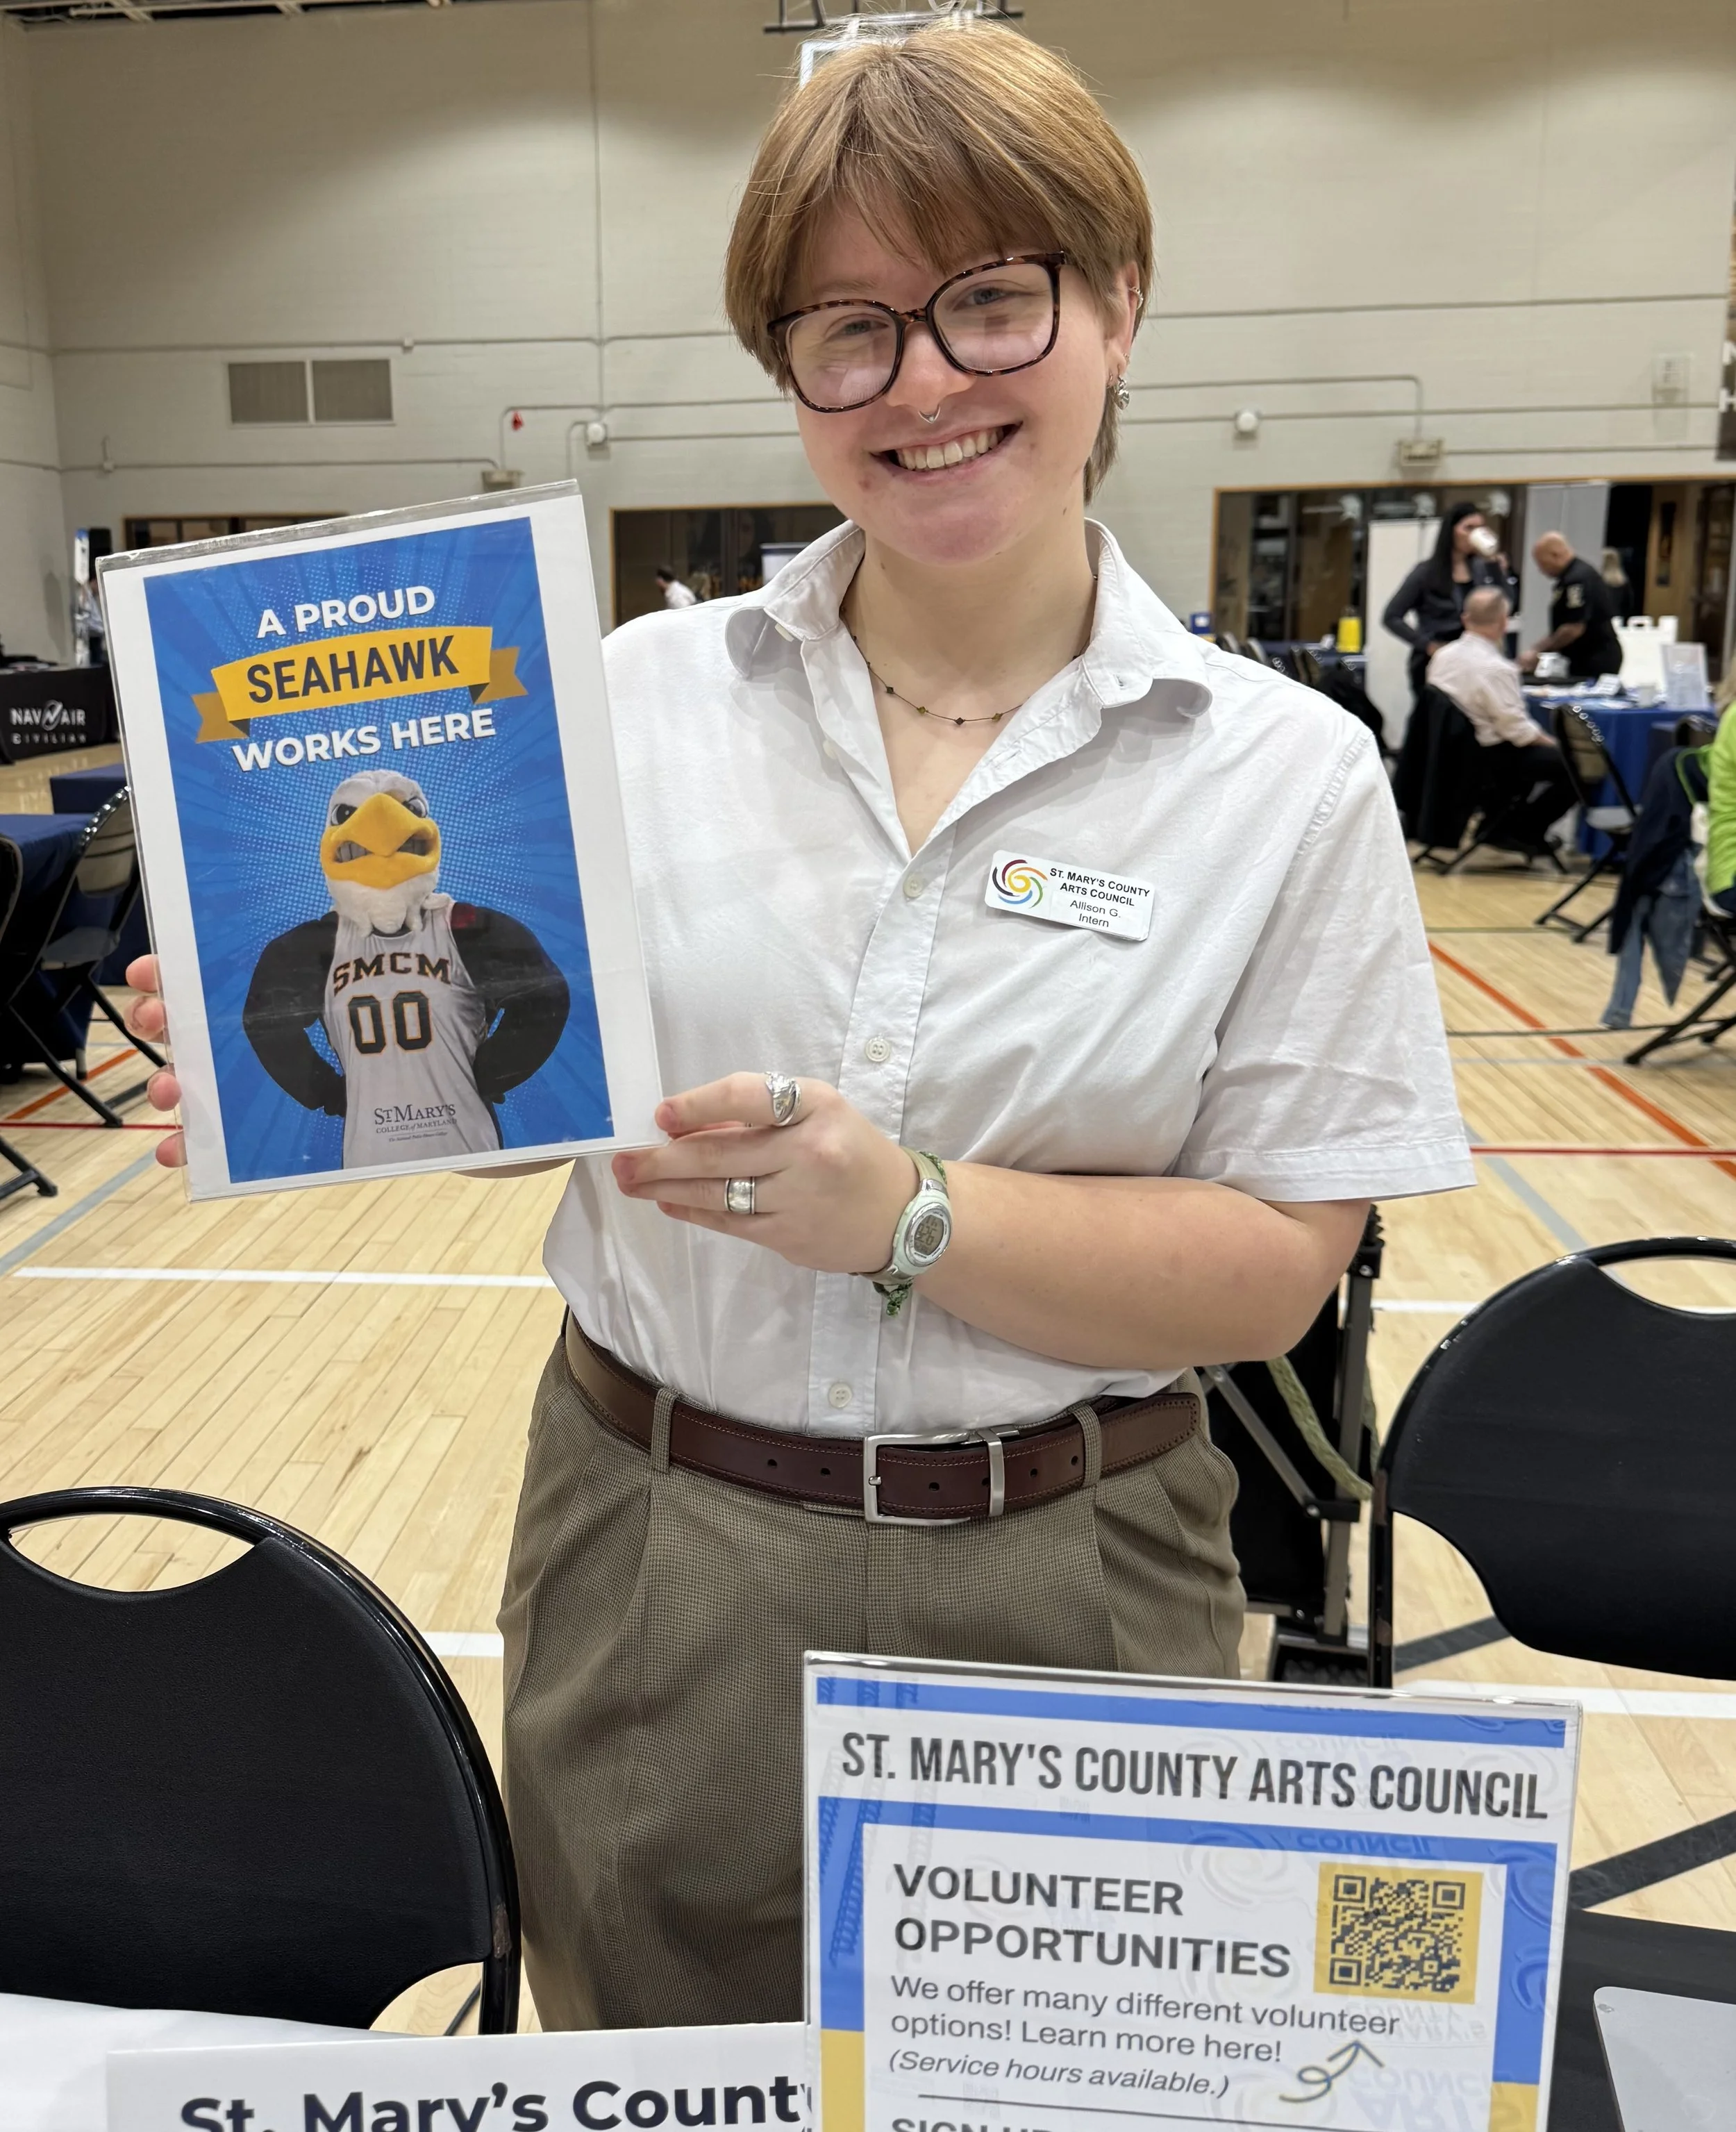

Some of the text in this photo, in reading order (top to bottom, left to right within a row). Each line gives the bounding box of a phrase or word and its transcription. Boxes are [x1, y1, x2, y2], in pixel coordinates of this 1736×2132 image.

[258, 585, 435, 639] A PROUD
[247, 635, 459, 704] SEAHAWK
[232, 708, 496, 772] WORKS HERE
[1050, 867, 1150, 897] ST. MARY'S COUNTY
[1060, 883, 1135, 906] ARTS COUNCIL
[1070, 900, 1121, 918] Allison G.
[1078, 913, 1109, 927] Intern
[333, 952, 451, 997] SMCM
[348, 990, 432, 1054] 00
[376, 1124, 408, 1133] COLLEGE
[842, 1732, 1548, 1819] ST. MARY'S COUNTY ARTS COUNCIL
[894, 1863, 1184, 1915] VOLUNTEER
[895, 1917, 1291, 1978] OPPORTUNITIES
[891, 1975, 1400, 2035] We offer many different volunteer
[891, 2013, 1281, 2063] options! Learn more here!
[889, 2049, 1229, 2099] (Service hours available.)
[181, 2097, 276, 2132] St
